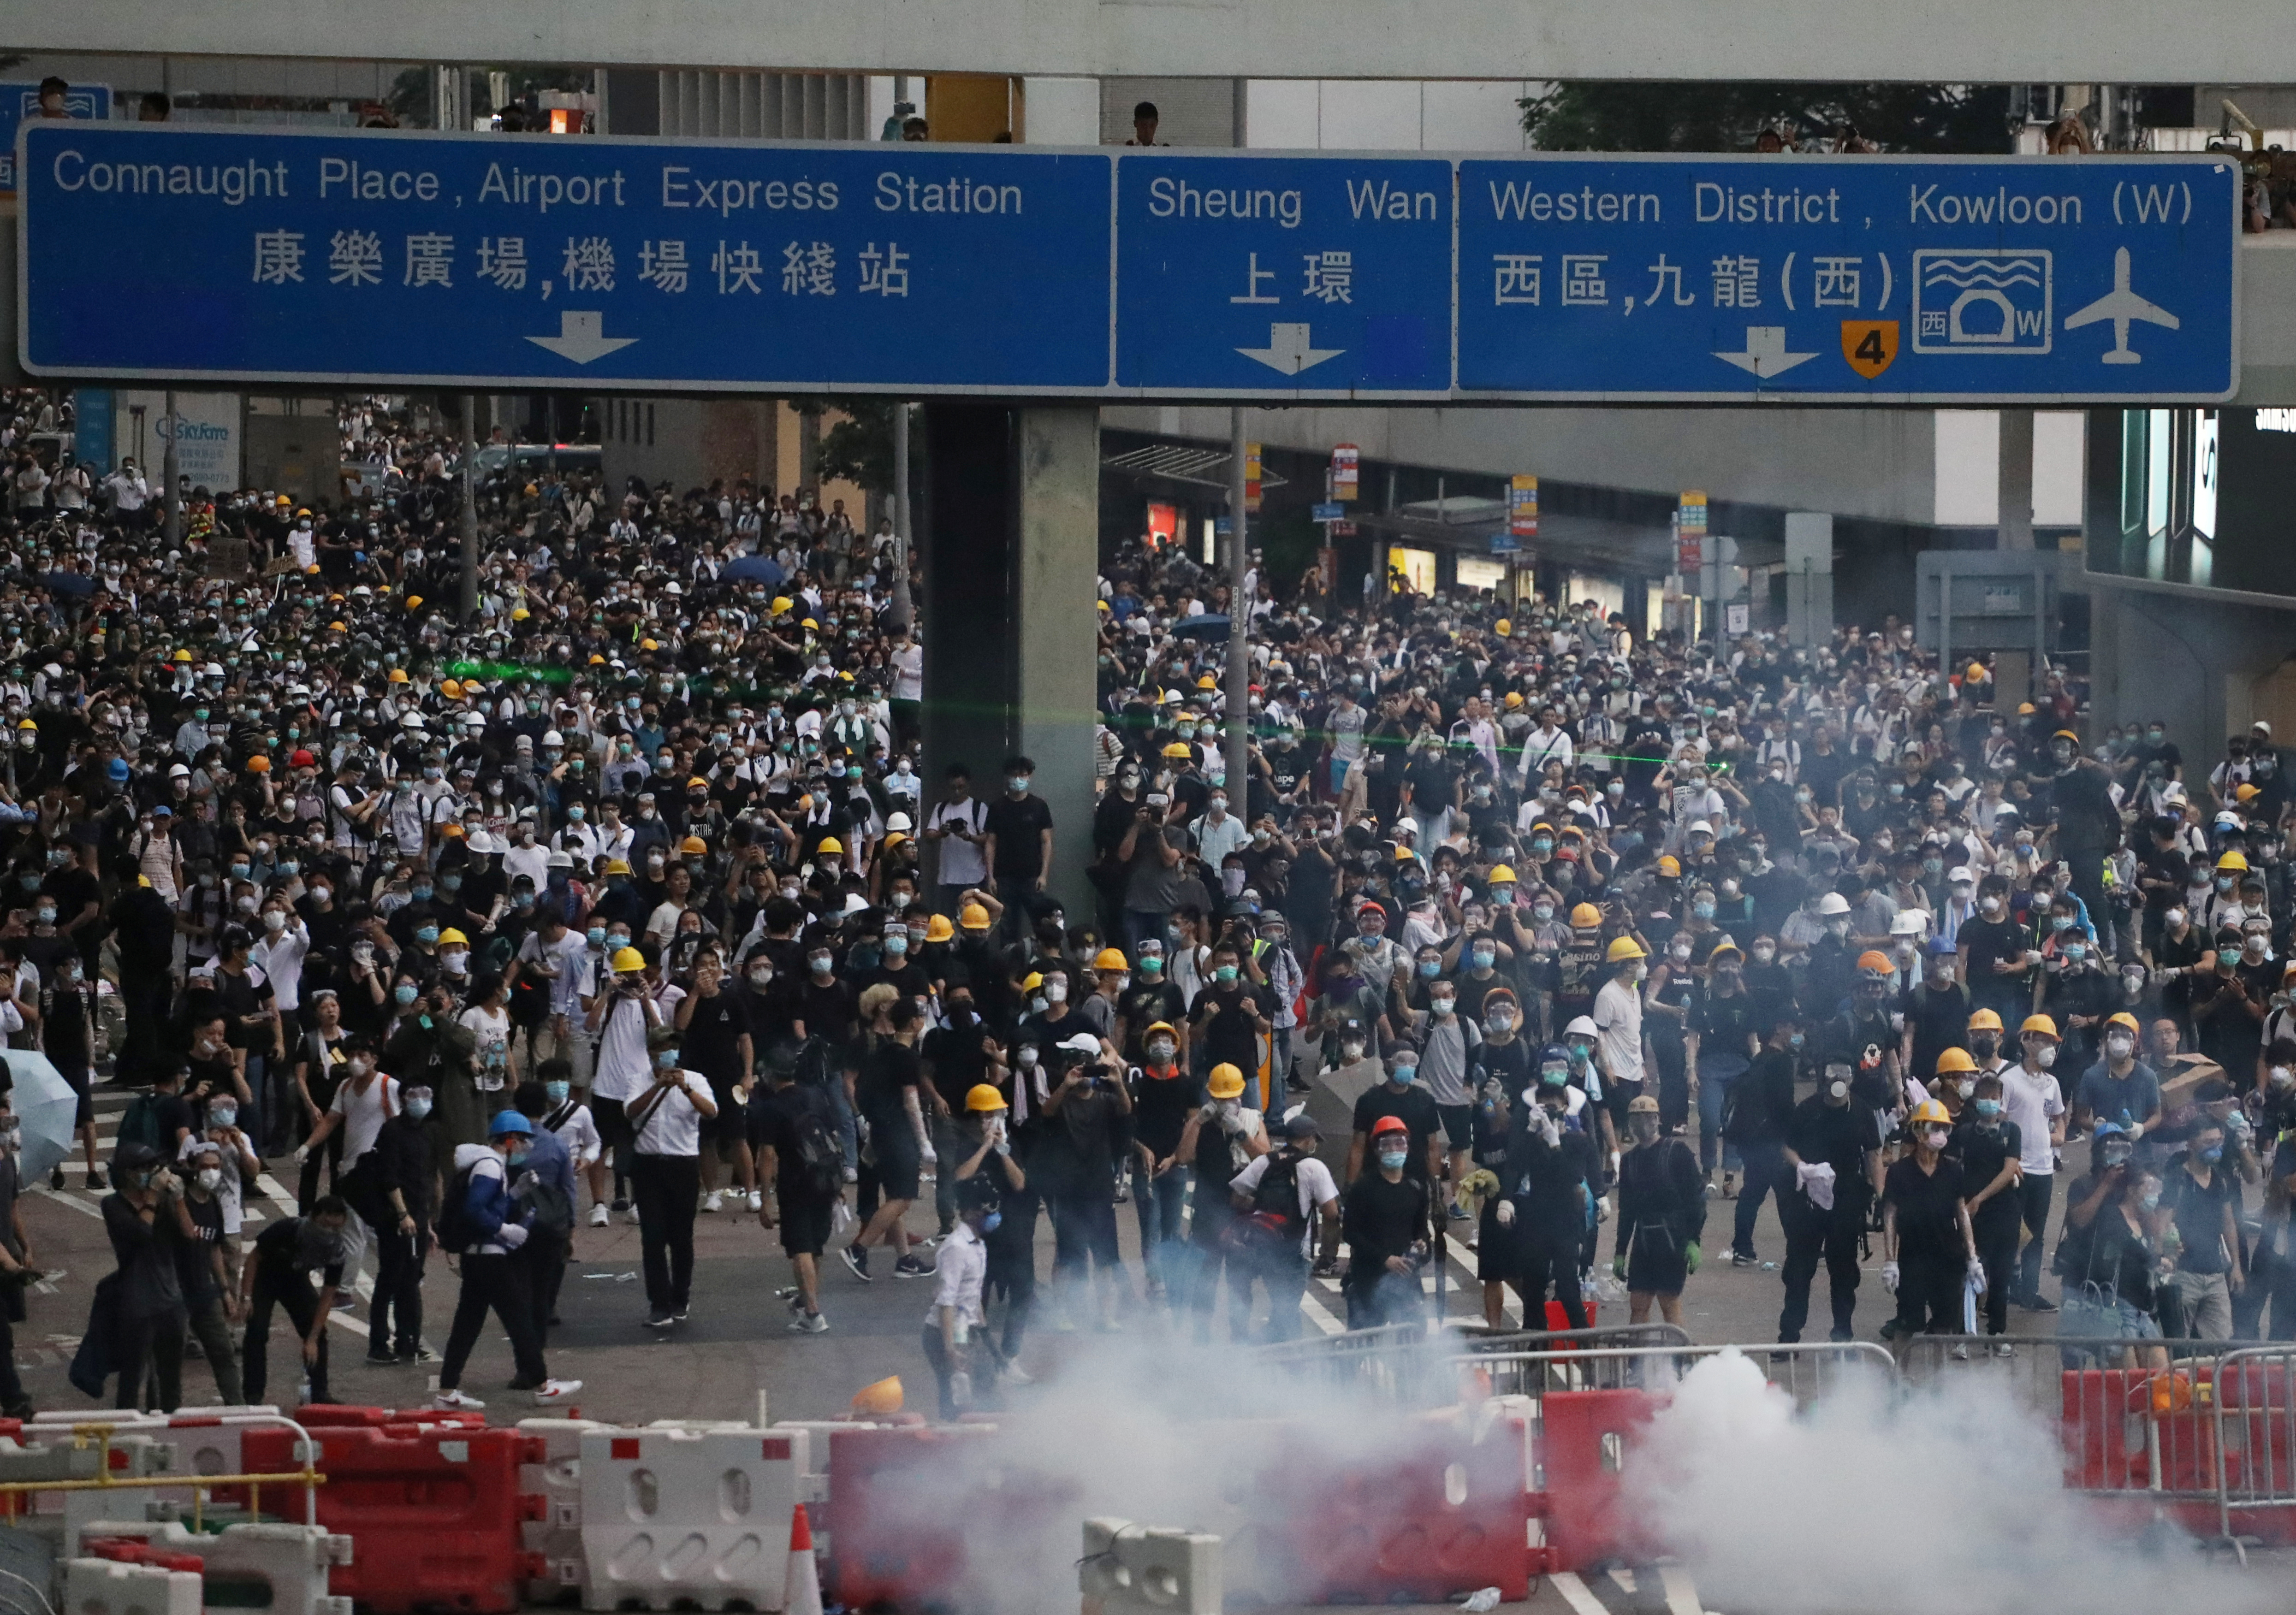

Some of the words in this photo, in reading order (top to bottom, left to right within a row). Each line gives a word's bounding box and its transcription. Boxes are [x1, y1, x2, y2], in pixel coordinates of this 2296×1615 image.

[54, 150, 288, 205] Connaught
[479, 162, 625, 213] Airport
[663, 166, 839, 218] Express
[875, 172, 1021, 214] Station
[1149, 177, 1301, 228] Sheung
[1347, 180, 1436, 220] Wan
[1490, 181, 1660, 222] Western
[1911, 184, 2082, 224] Kowloon
[2113, 182, 2191, 225] (W)
[1230, 251, 1353, 304] 上環
[1921, 311, 1946, 337] 西
[2016, 310, 2043, 336] W
[1855, 331, 1885, 364] 4
